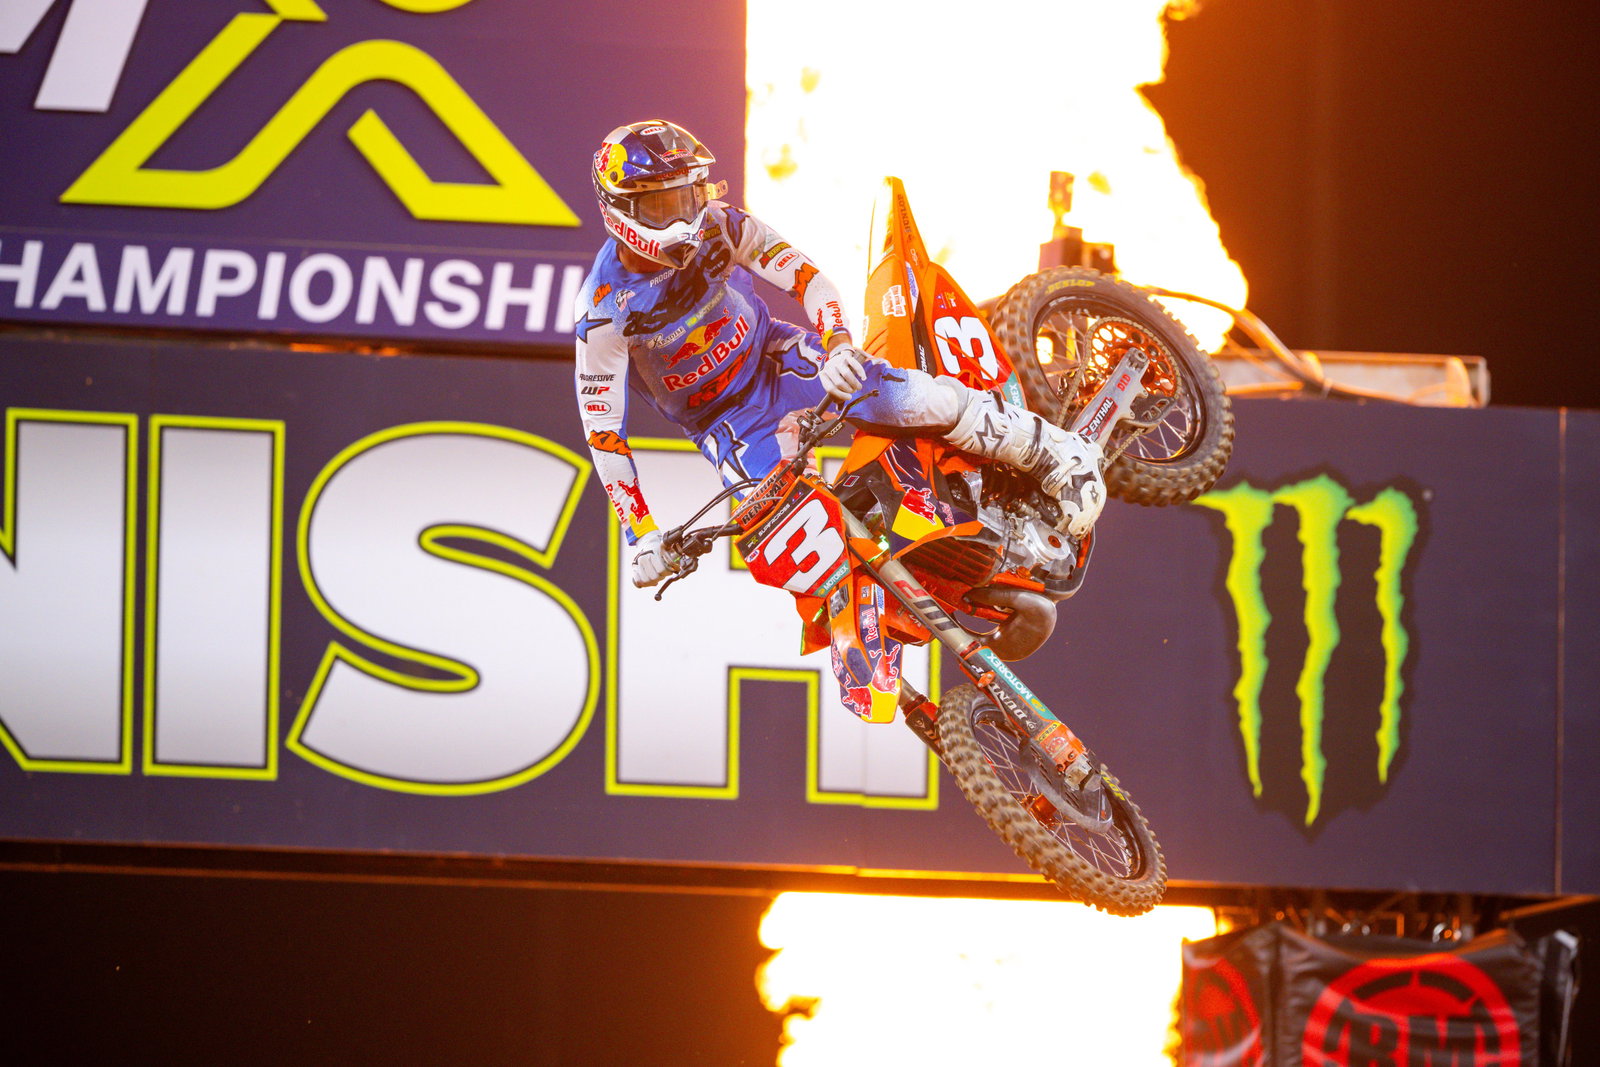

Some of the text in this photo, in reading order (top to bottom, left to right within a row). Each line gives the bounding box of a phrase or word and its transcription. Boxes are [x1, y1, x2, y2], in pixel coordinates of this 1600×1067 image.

[625, 226, 661, 258] Bull
[777, 253, 796, 268] BELL
[662, 353, 716, 392] Red
[710, 313, 750, 366] Bull
[934, 316, 999, 381] 3
[581, 386, 610, 396] WP
[586, 404, 607, 412] BELL
[741, 479, 788, 526] RENTHAL
[764, 499, 845, 593] 3
[823, 566, 849, 590] MOTOREX
[970, 664, 1028, 721] DUNLP
[988, 652, 1032, 700] MOTOREX
